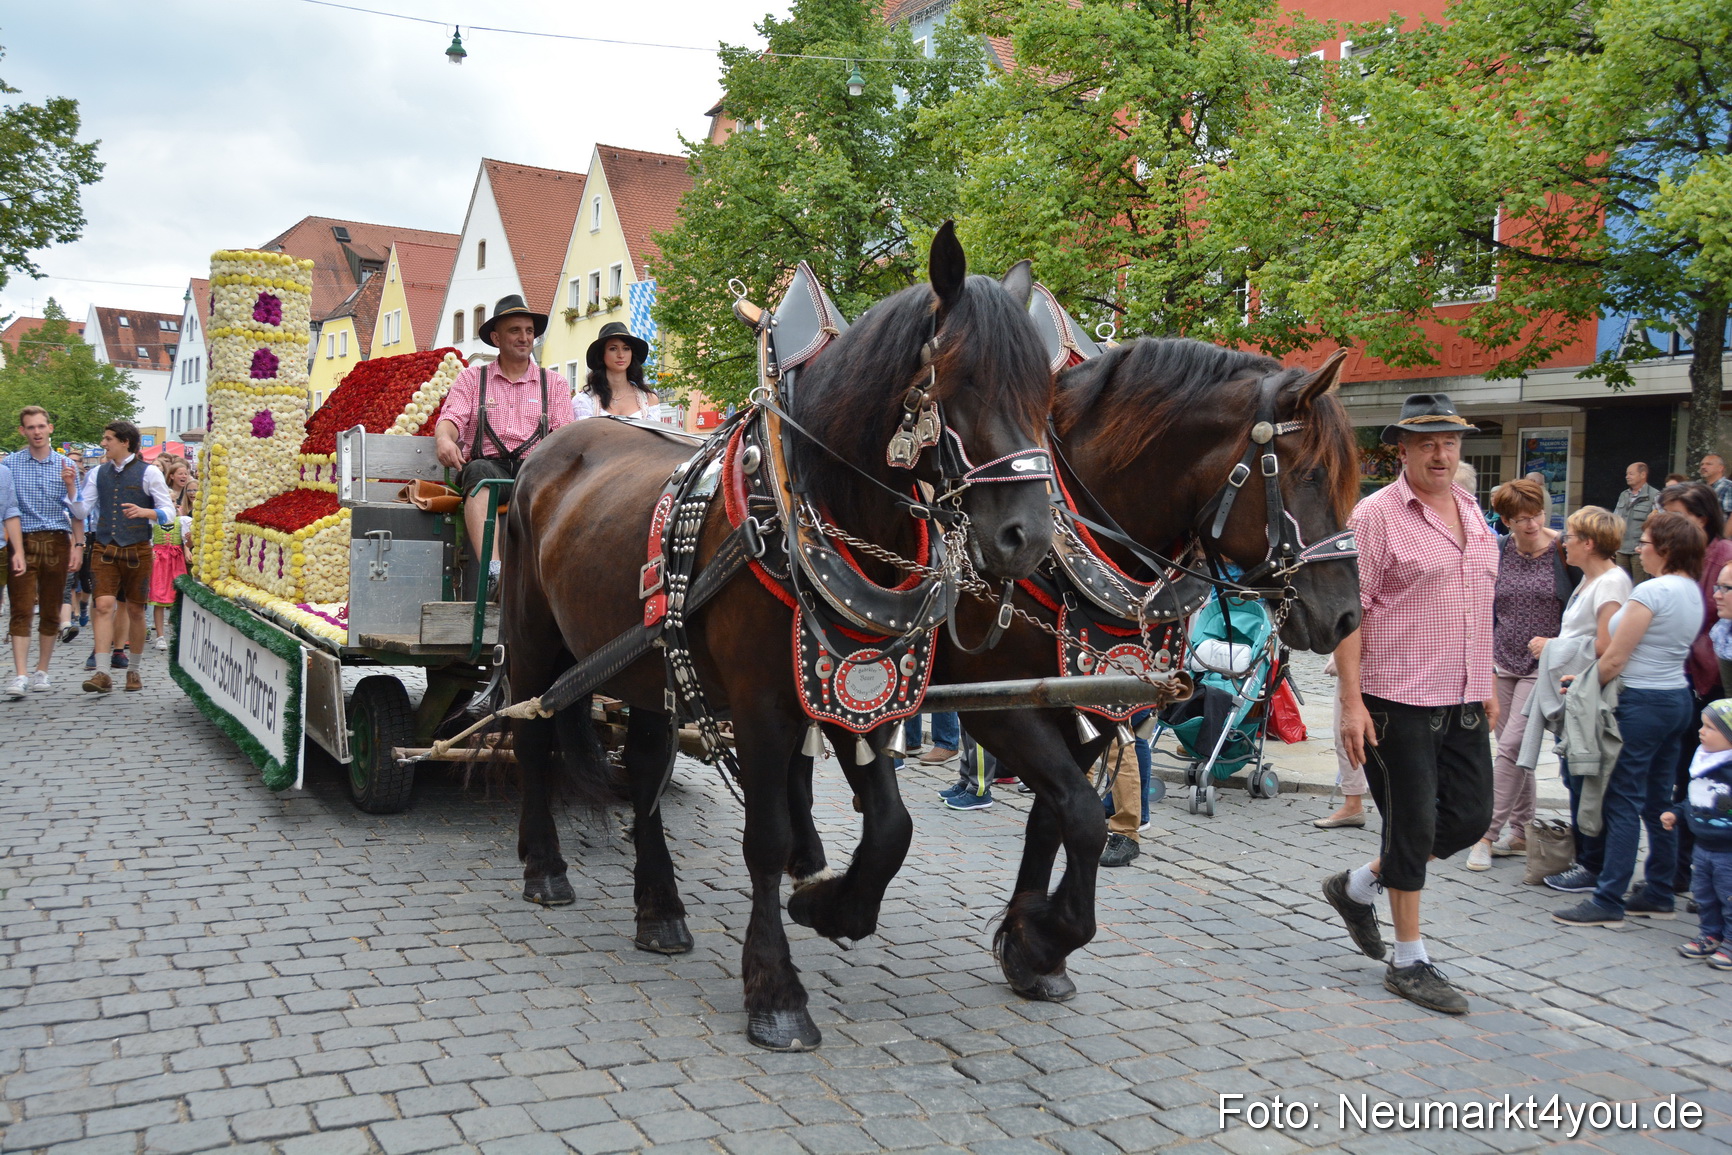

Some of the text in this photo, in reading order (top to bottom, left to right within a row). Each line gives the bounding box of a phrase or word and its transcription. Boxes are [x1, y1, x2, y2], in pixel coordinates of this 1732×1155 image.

[190, 610, 278, 734] 70 Jahre schon Pfarrei
